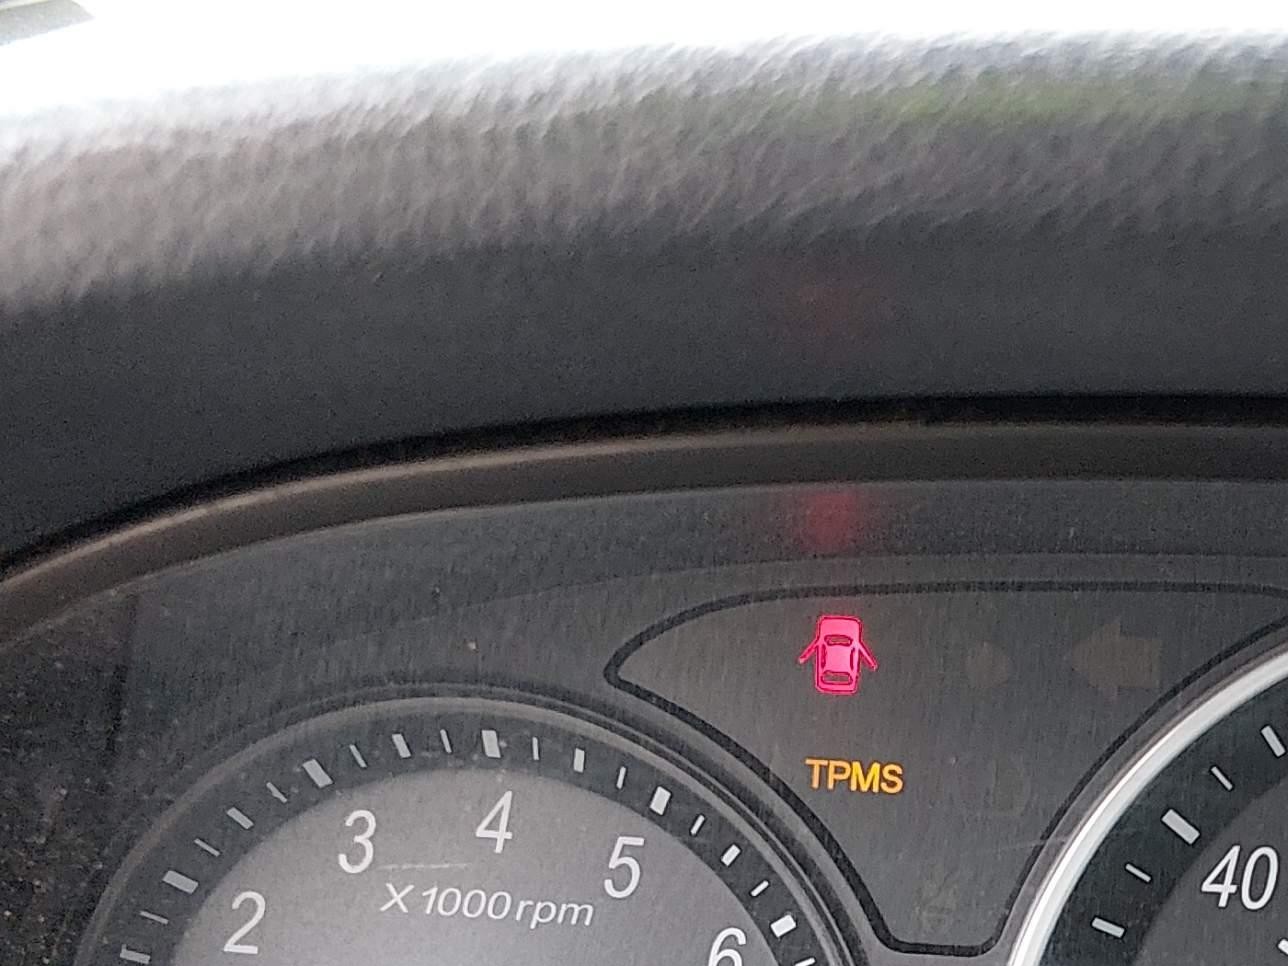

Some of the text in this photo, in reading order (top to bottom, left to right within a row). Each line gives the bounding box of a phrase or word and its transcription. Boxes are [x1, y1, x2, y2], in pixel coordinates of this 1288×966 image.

[805, 758, 904, 794] TPMS
[338, 809, 377, 873] 3
[475, 790, 513, 853] 4
[603, 836, 645, 900] 5
[1200, 844, 1280, 910] 40
[223, 891, 267, 954] 2
[422, 886, 513, 922] 1000
[514, 896, 596, 928] rpm
